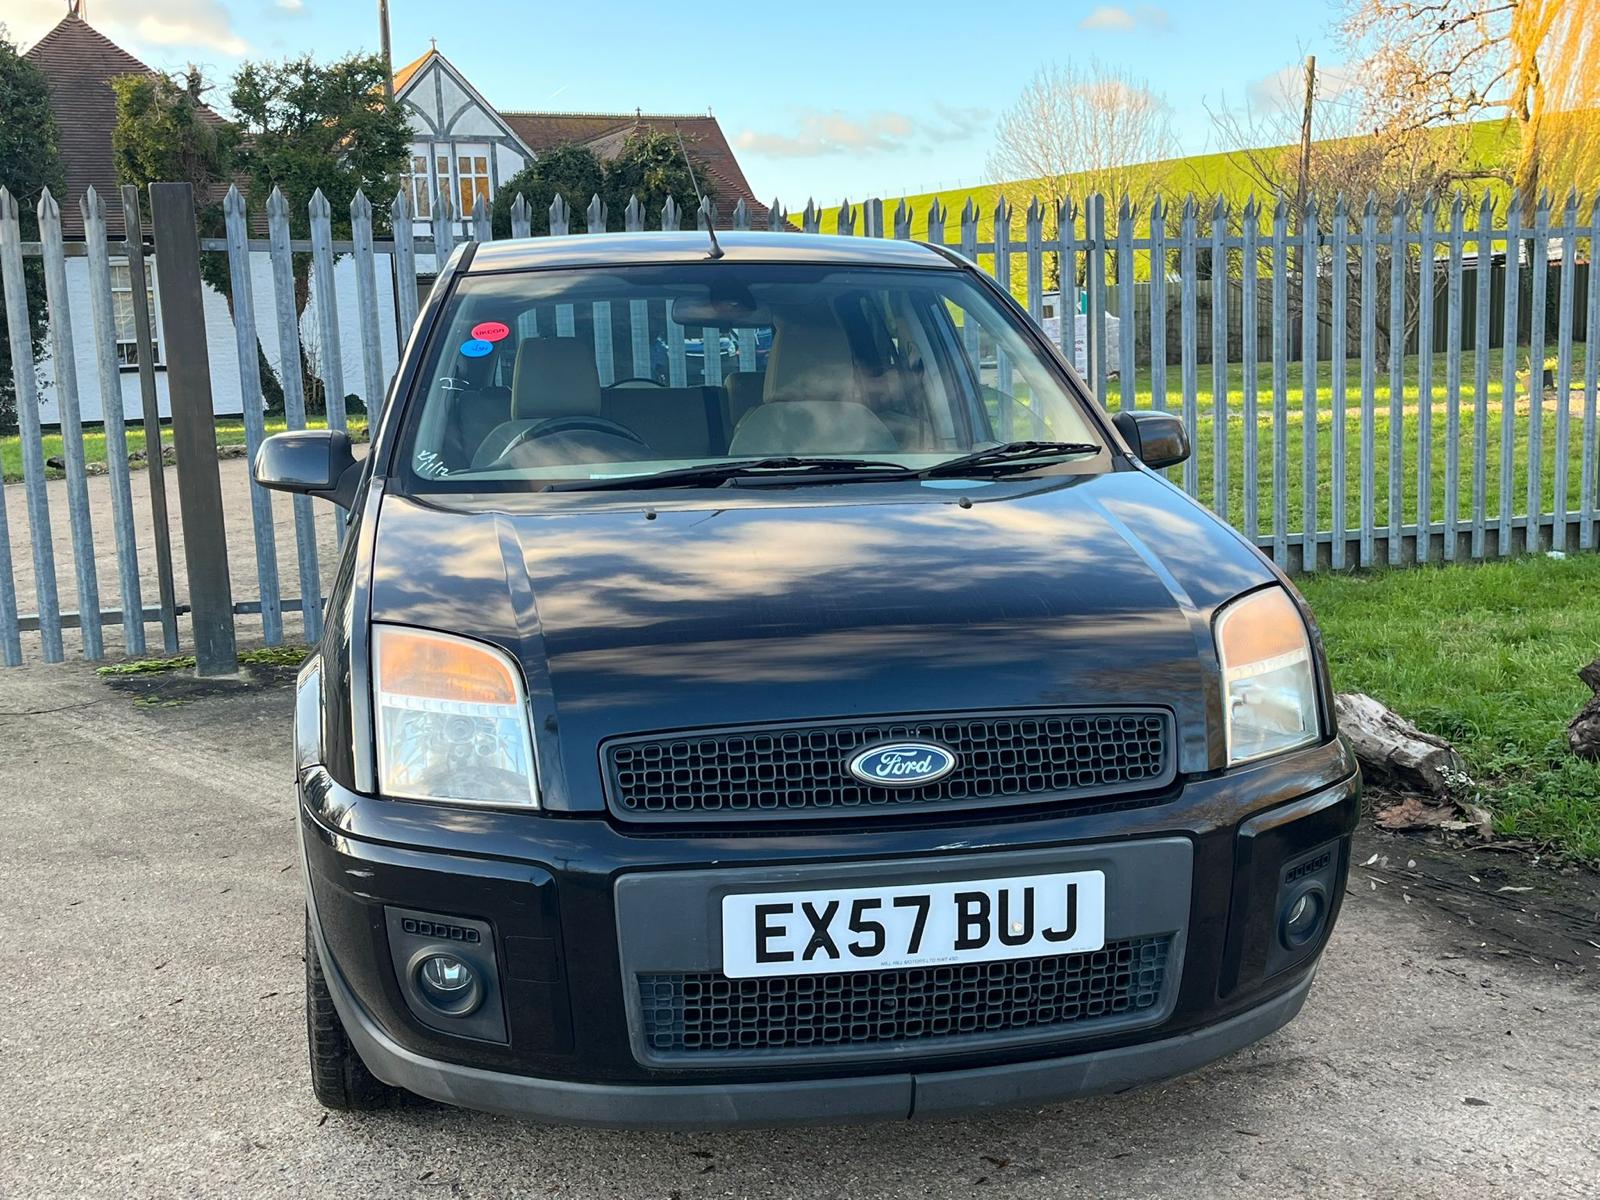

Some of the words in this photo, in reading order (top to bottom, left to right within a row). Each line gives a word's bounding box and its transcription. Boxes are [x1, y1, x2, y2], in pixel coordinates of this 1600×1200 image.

[876, 751, 932, 776] Ford
[755, 894, 931, 963] EX57
[954, 883, 1078, 951] BUJ
